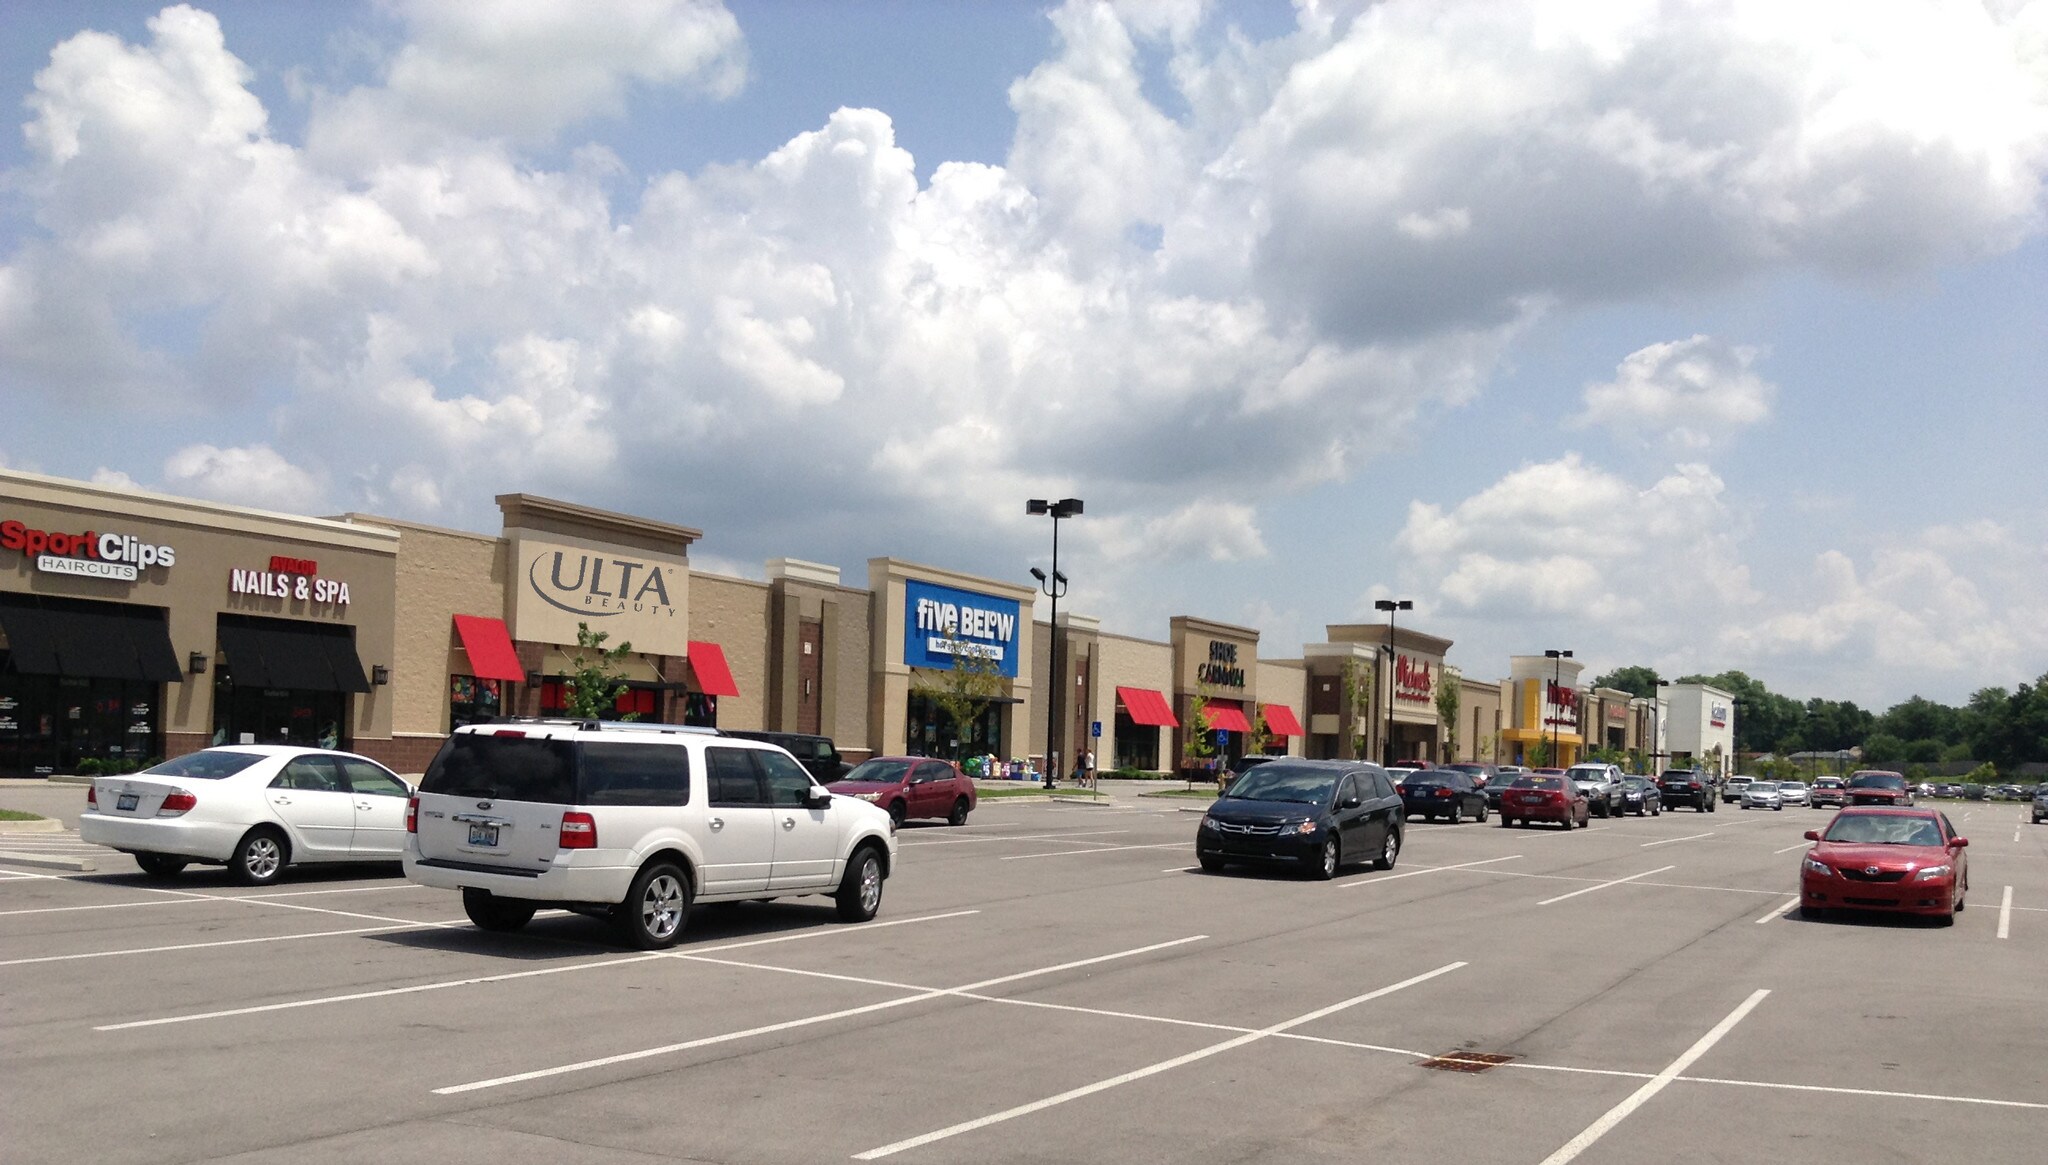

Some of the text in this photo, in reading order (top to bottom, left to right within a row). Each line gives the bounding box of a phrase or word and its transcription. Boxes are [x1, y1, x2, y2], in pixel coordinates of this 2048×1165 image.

[42, 558, 133, 578] HAIRCUTS
[269, 555, 317, 575] AVALON
[231, 568, 350, 605] NAILS & SPA
[551, 551, 670, 606] ULTA
[584, 595, 676, 617] BEAUTY
[961, 606, 1014, 642] BELOW
[1209, 640, 1237, 663] SHOE
